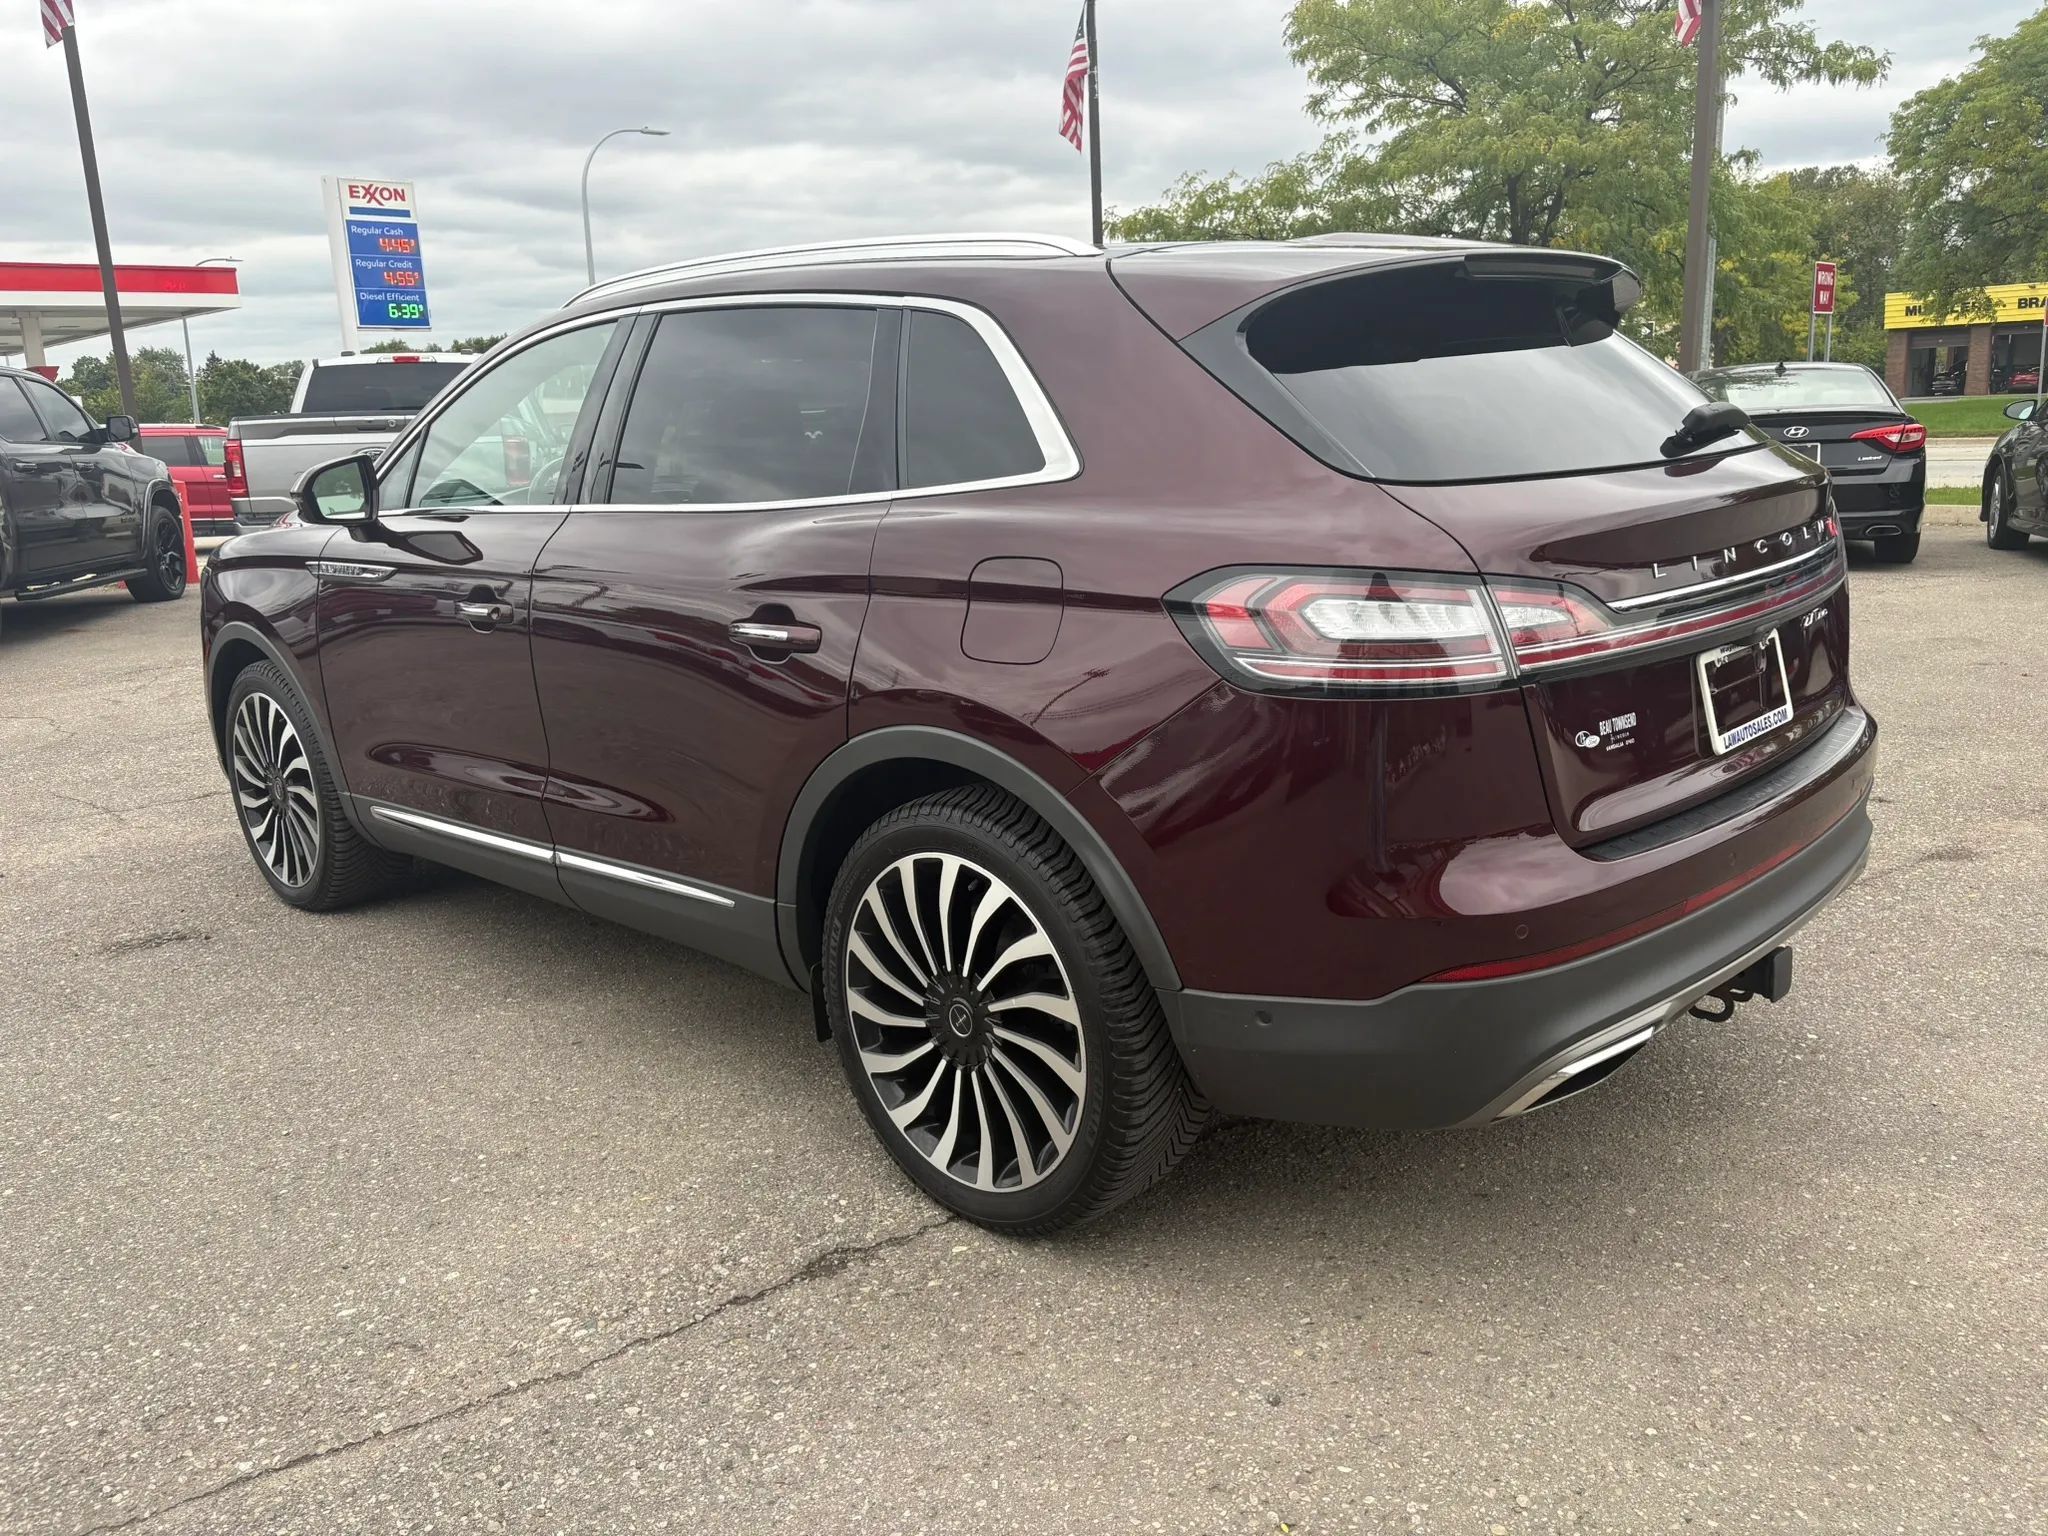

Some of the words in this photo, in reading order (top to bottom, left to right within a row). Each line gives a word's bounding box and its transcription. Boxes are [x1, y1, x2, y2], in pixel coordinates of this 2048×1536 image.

[348, 184, 406, 206] EXXON
[351, 225, 382, 236] Regular
[383, 227, 404, 236] Cash
[355, 259, 387, 269] Regular
[389, 260, 413, 269] Credit
[1817, 271, 1834, 286] WRONG
[360, 292, 385, 301] Diesel
[387, 292, 420, 302] Efficient
[1819, 290, 1830, 304] WAY
[1652, 519, 1825, 579] LINCOLN
[1612, 712, 1636, 732] TOWNSEND
[1723, 708, 1788, 749] LAWAUTOSALES.COM
